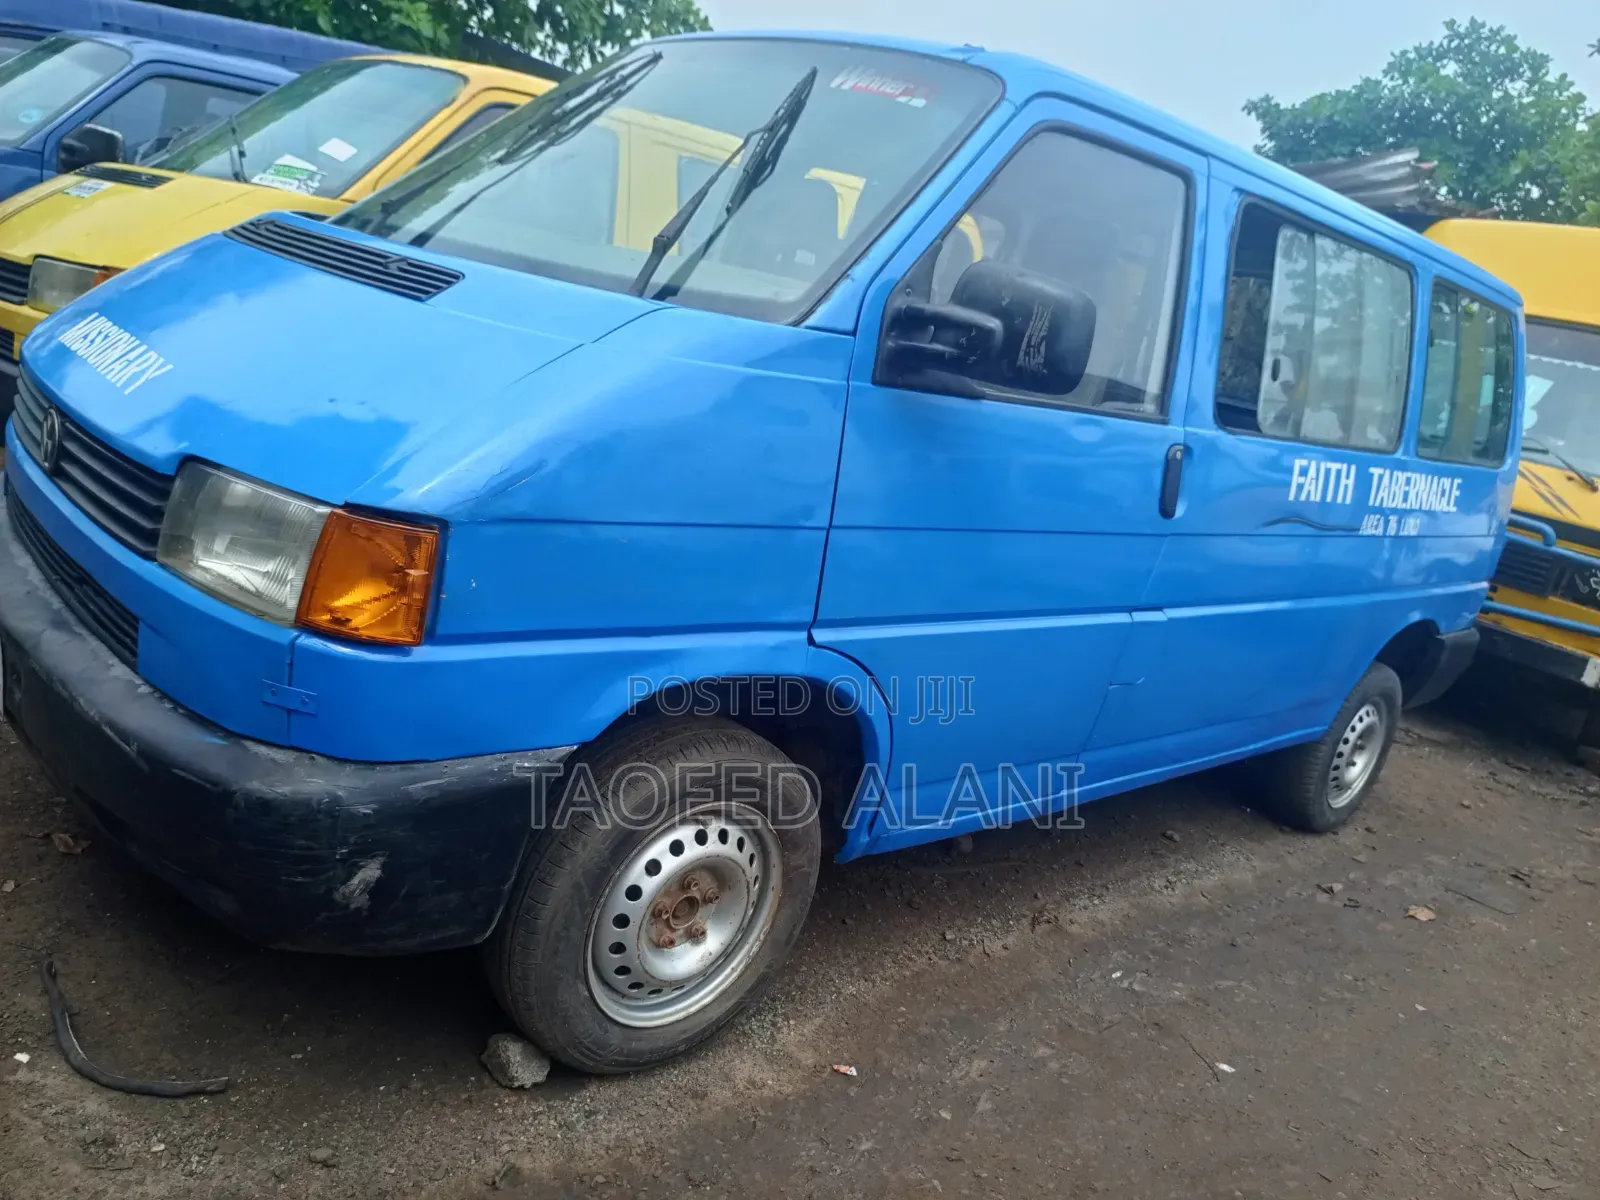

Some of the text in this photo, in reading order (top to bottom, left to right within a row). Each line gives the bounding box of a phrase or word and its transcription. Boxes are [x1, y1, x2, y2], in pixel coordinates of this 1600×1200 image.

[58, 312, 174, 395] MISSIONARY
[1288, 458, 1462, 512] FAITH TABERNACLE
